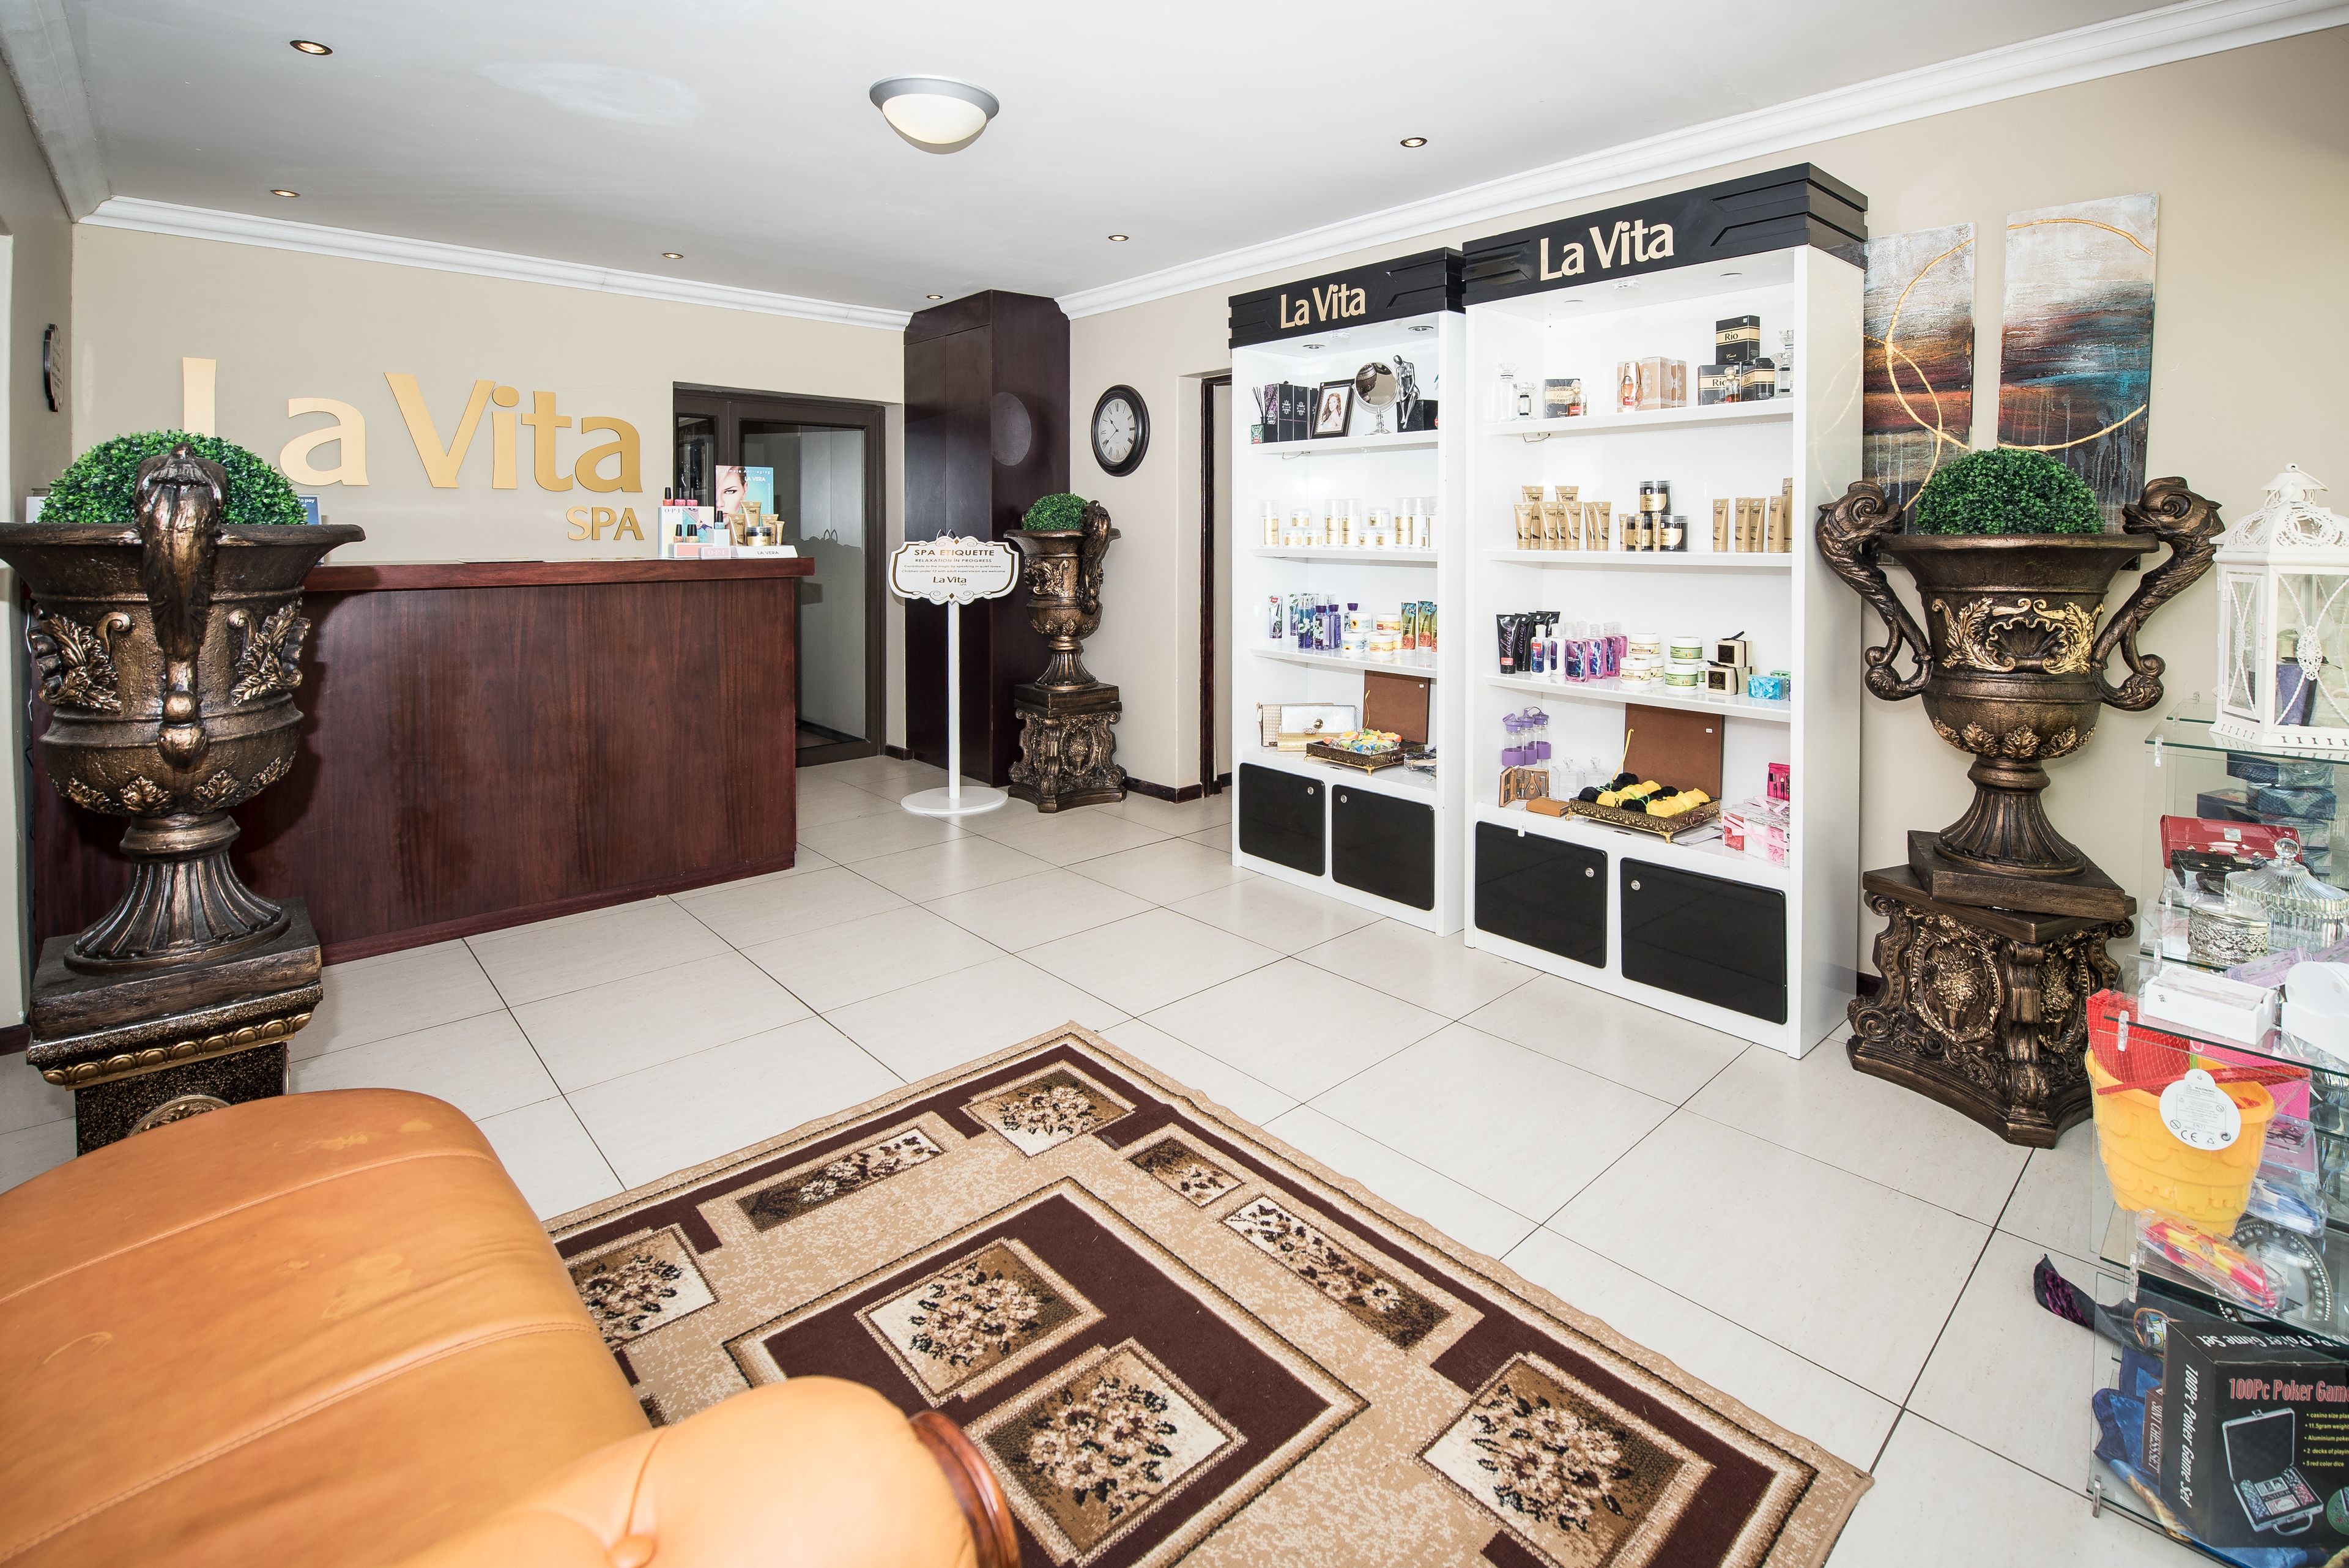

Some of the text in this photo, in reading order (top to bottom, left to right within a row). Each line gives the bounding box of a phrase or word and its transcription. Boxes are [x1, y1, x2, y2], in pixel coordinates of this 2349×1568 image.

[1540, 219, 1674, 281] La Vita
[1281, 283, 1366, 329] La Vita
[1725, 332, 1739, 341] Rio
[384, 373, 643, 492] Vita
[567, 505, 645, 541] SPA
[2196, 1336, 2227, 1347] Set
[2222, 1336, 2267, 1348] Game
[2229, 1378, 2269, 1400] 100Pc
[2273, 1379, 2313, 1401] Poker
[2180, 1364, 2199, 1509] 100Pc Poker Game Set
